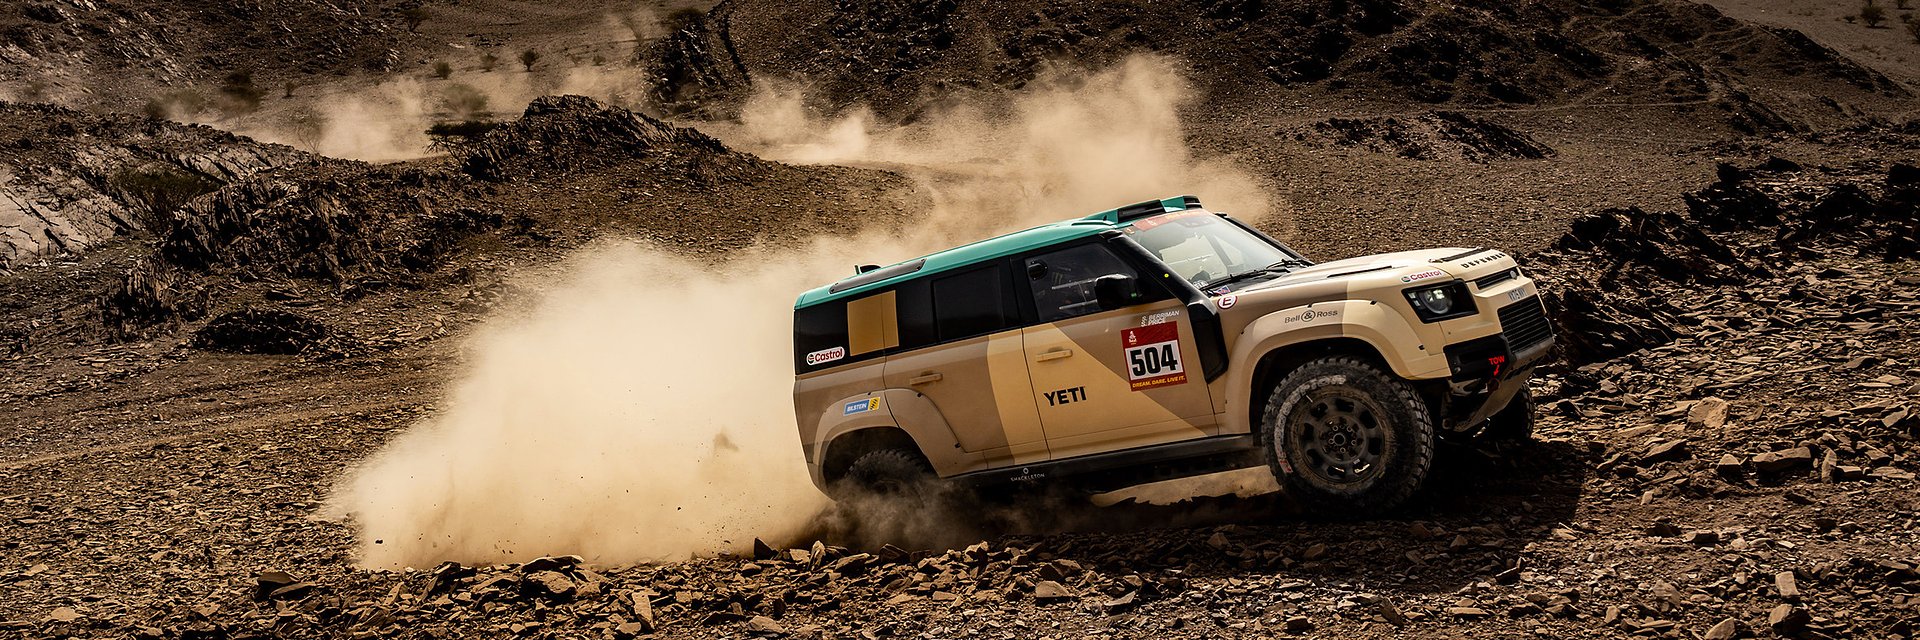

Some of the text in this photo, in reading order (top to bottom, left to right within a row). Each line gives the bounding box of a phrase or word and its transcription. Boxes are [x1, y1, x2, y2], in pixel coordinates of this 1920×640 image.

[1410, 270, 1442, 281] Castrol
[1284, 315, 1301, 324] Bell
[1316, 310, 1338, 318] Ross
[814, 349, 843, 361] Castrol
[1130, 344, 1178, 376] 504
[1488, 355, 1505, 366] TOW
[1043, 386, 1087, 407] YETI
[1010, 473, 1045, 482] SHACKLETON
